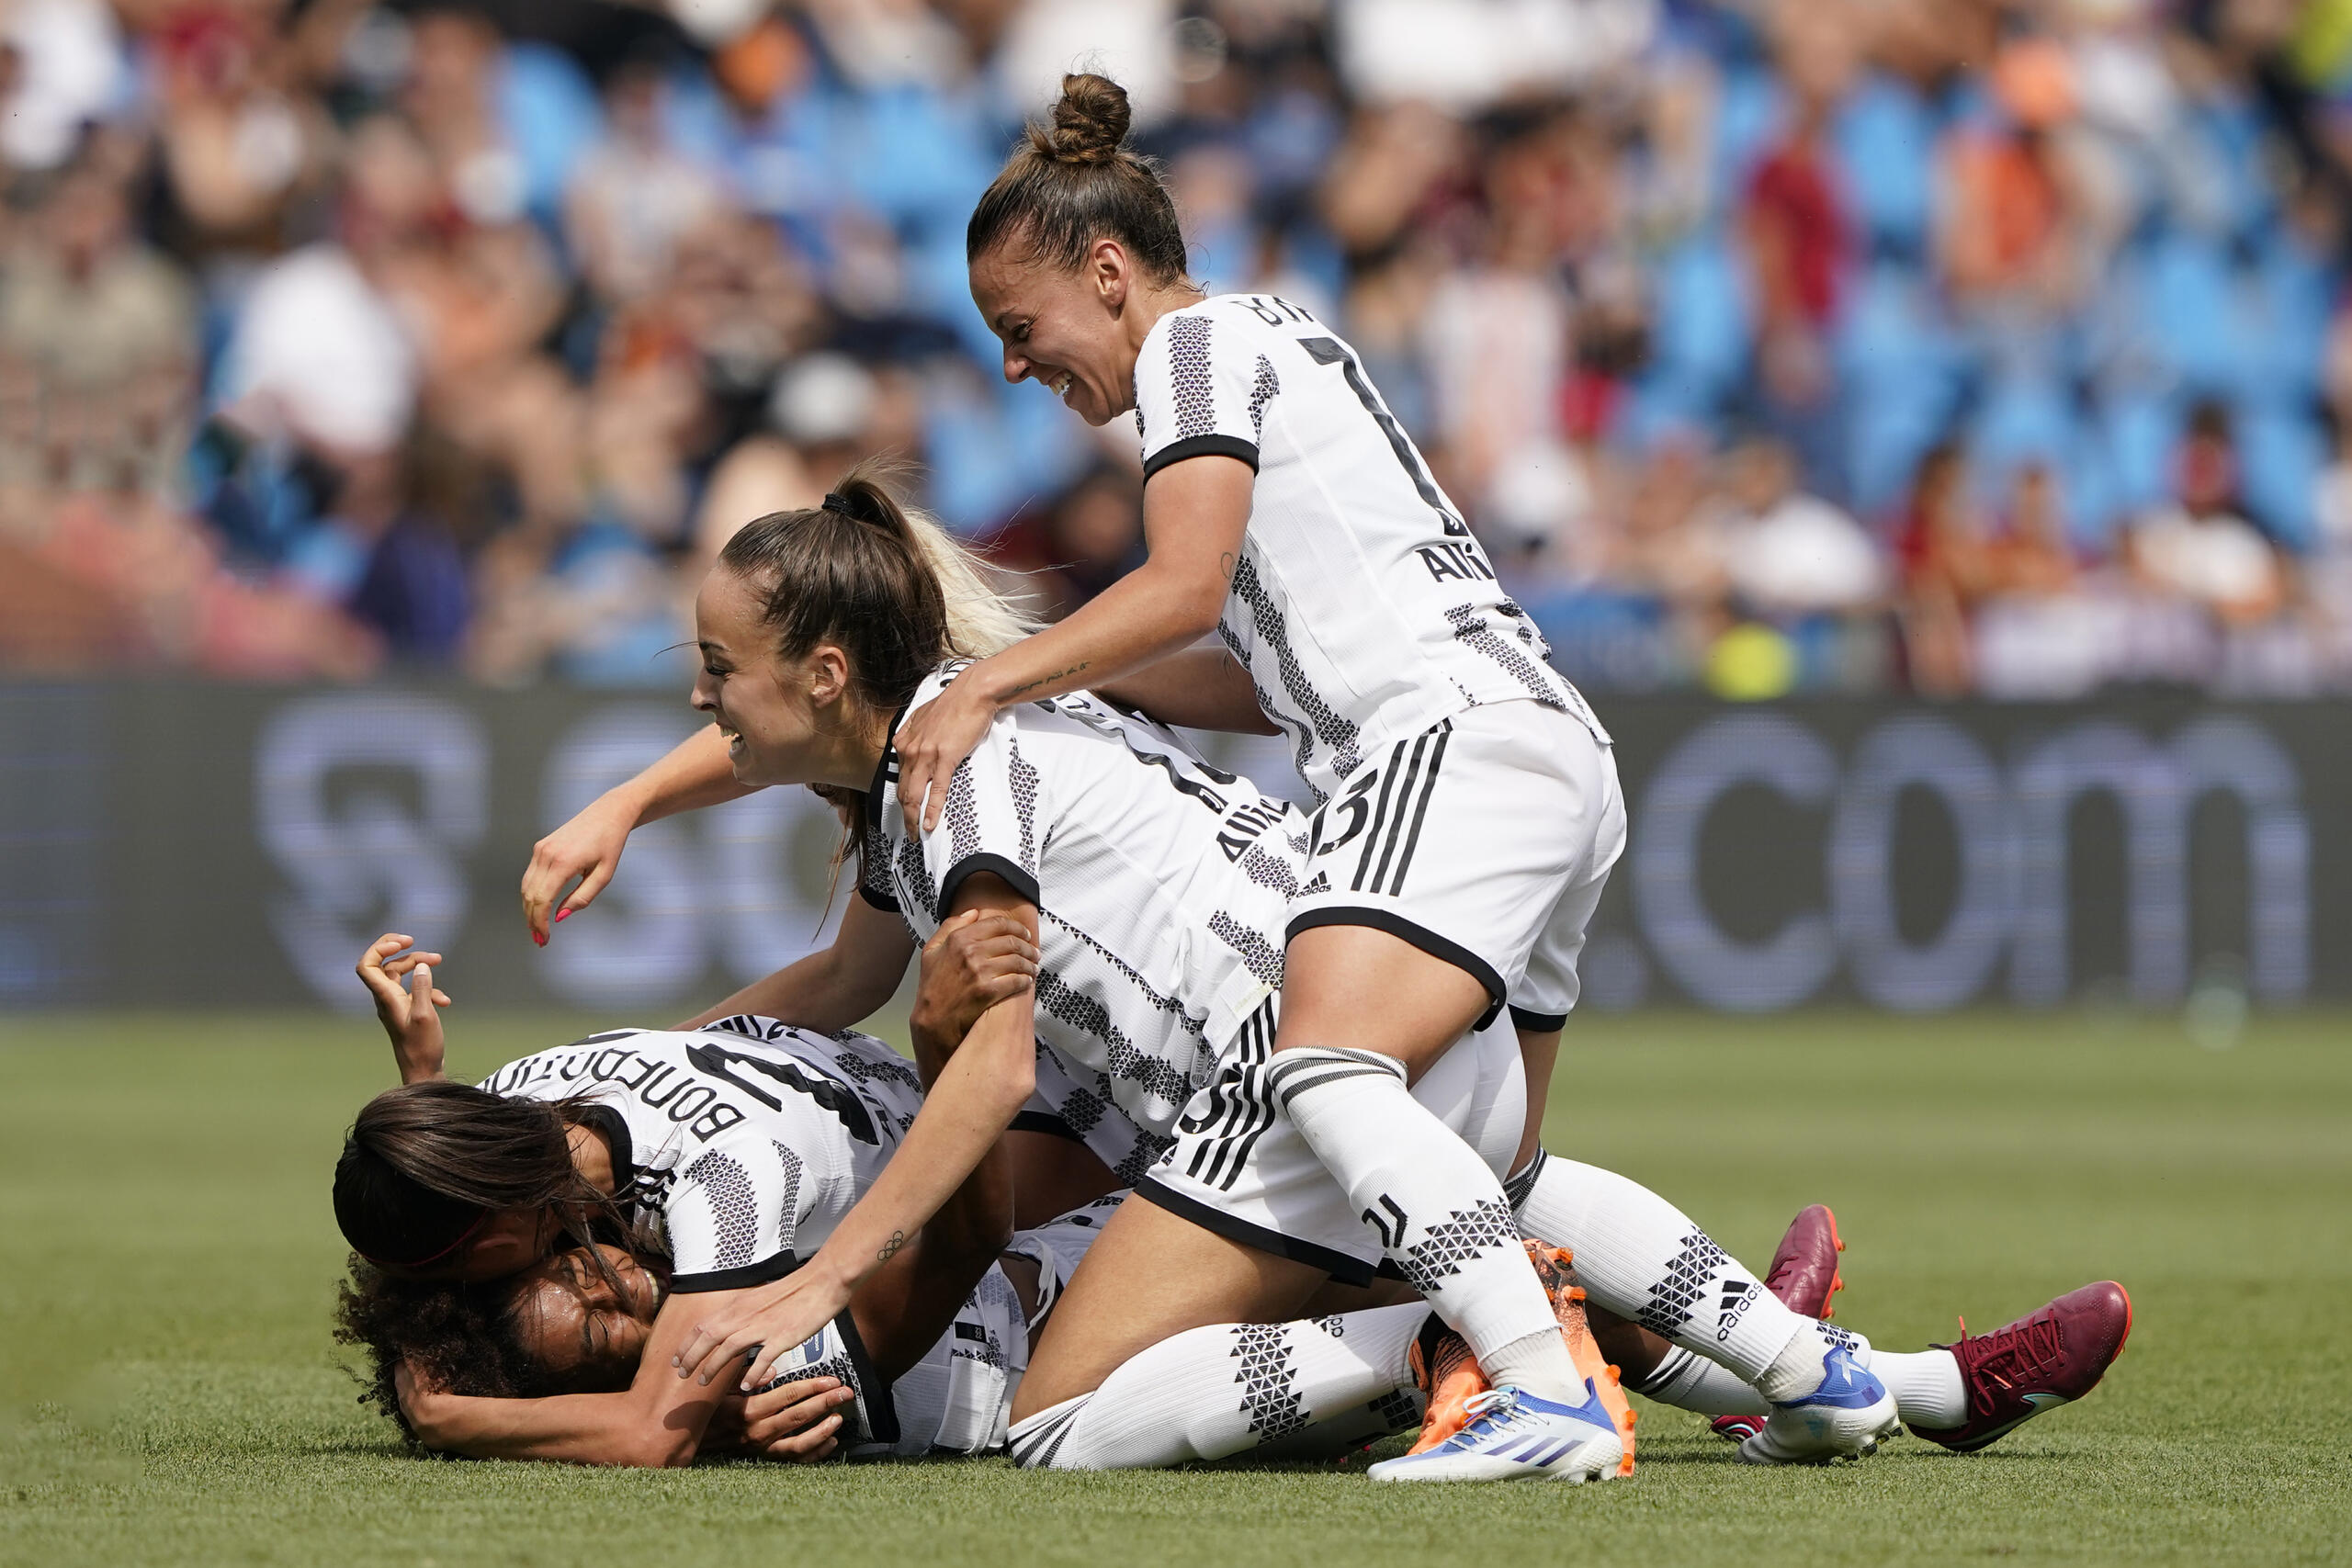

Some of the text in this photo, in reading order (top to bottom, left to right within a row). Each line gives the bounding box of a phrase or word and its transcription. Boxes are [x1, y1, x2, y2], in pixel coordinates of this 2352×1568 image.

[1415, 542, 1496, 583] Alli
[1295, 883, 1332, 899] adidas
[1716, 1281, 1763, 1342] adidas
